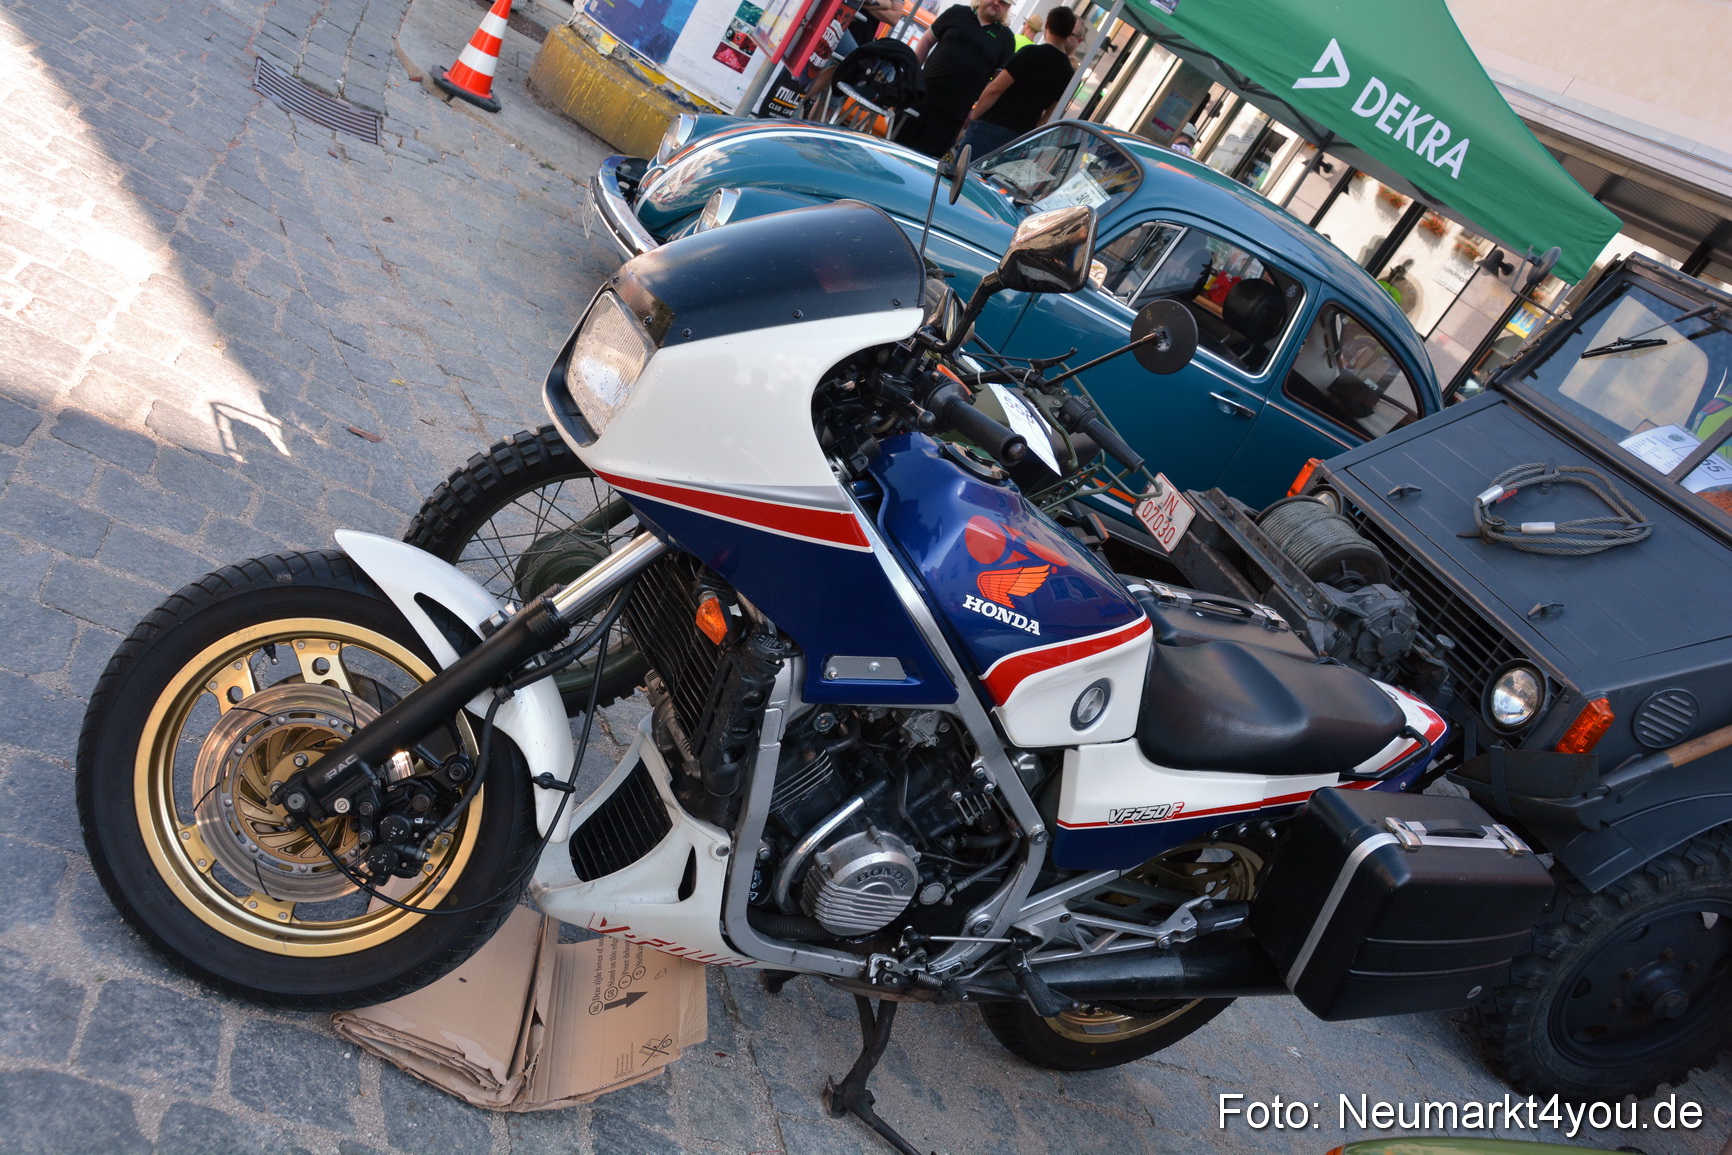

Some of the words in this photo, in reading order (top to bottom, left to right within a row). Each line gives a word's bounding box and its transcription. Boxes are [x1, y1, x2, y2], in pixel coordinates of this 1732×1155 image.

[1351, 76, 1470, 180] DEKRA
[1141, 500, 1176, 544] 07030
[962, 594, 1041, 636] HONDA
[1107, 801, 1185, 825] VF750F
[855, 866, 908, 891] HONDA
[610, 961, 616, 969] on
[607, 970, 616, 987] Stand
